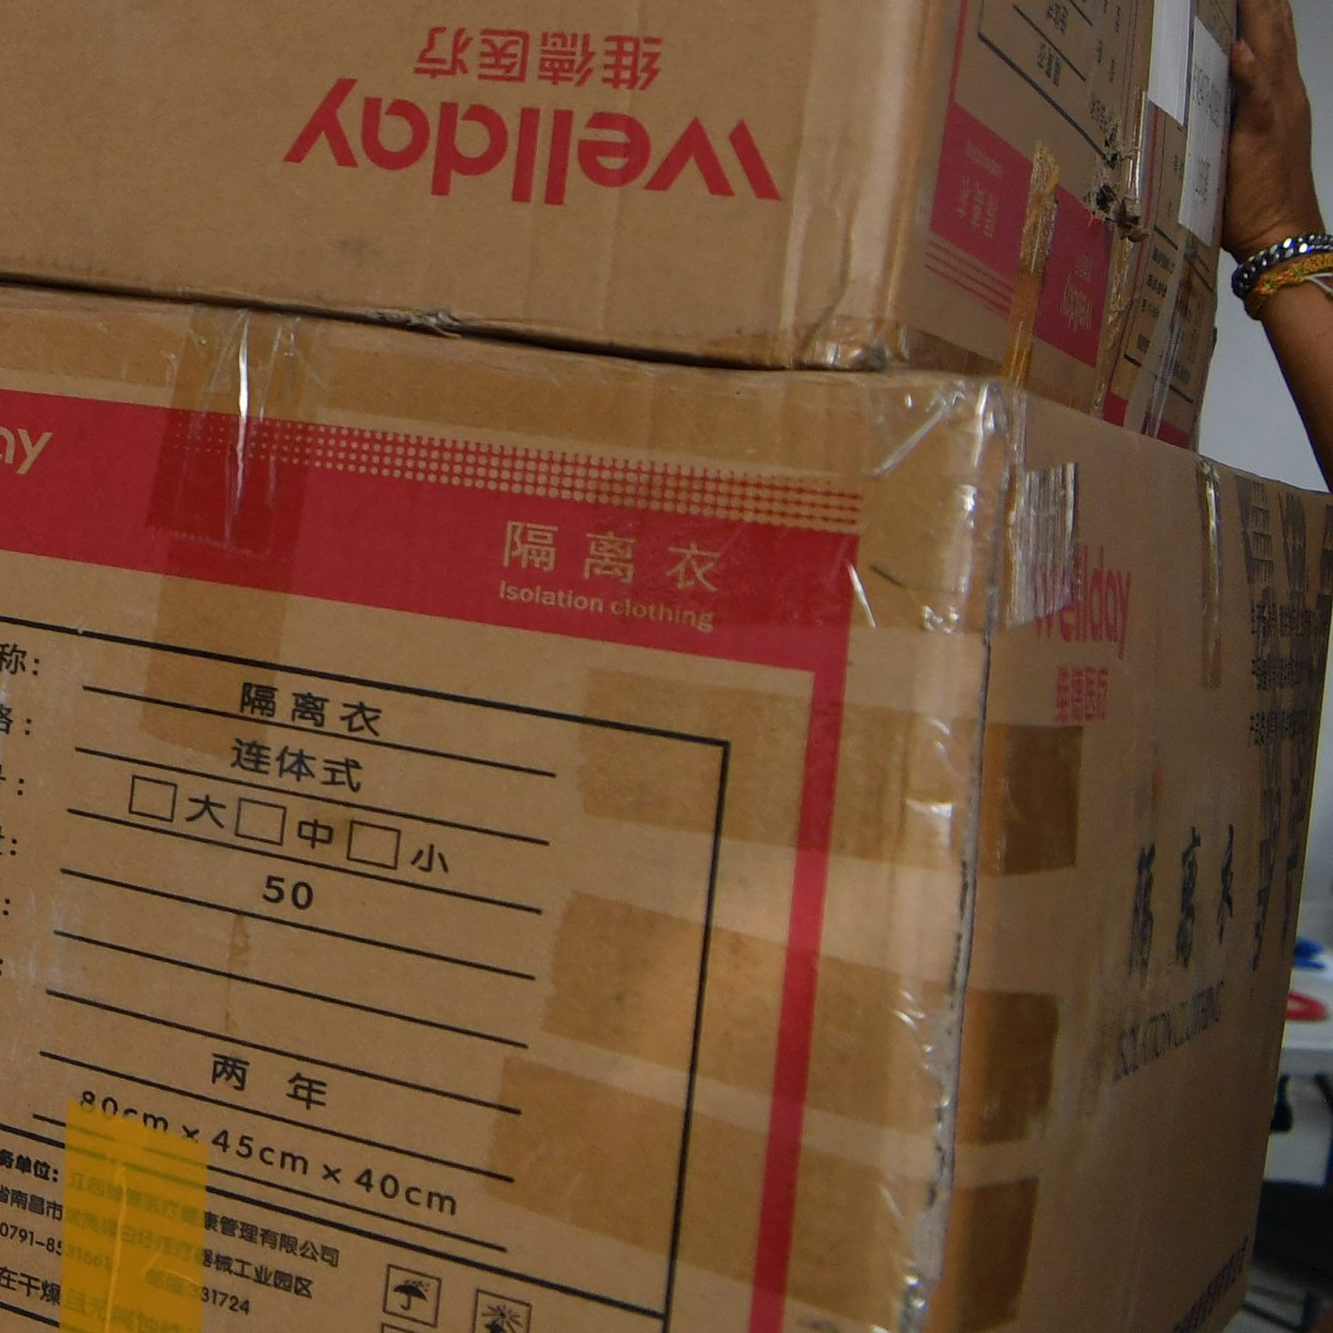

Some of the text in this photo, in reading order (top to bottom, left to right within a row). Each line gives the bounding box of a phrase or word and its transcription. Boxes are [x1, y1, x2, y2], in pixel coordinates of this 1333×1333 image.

[414, 25, 663, 90] 维德医疗
[283, 77, 782, 206] wellday
[500, 519, 721, 594] 隔离衣
[498, 579, 716, 633] Isolation clothing
[239, 680, 384, 737] 隔离衣
[229, 737, 363, 793] 连体式
[261, 873, 315, 913] 50
[210, 1051, 329, 1111] 两年
[210, 1129, 310, 1177] 45cm
[355, 1167, 459, 1216] 40cm
